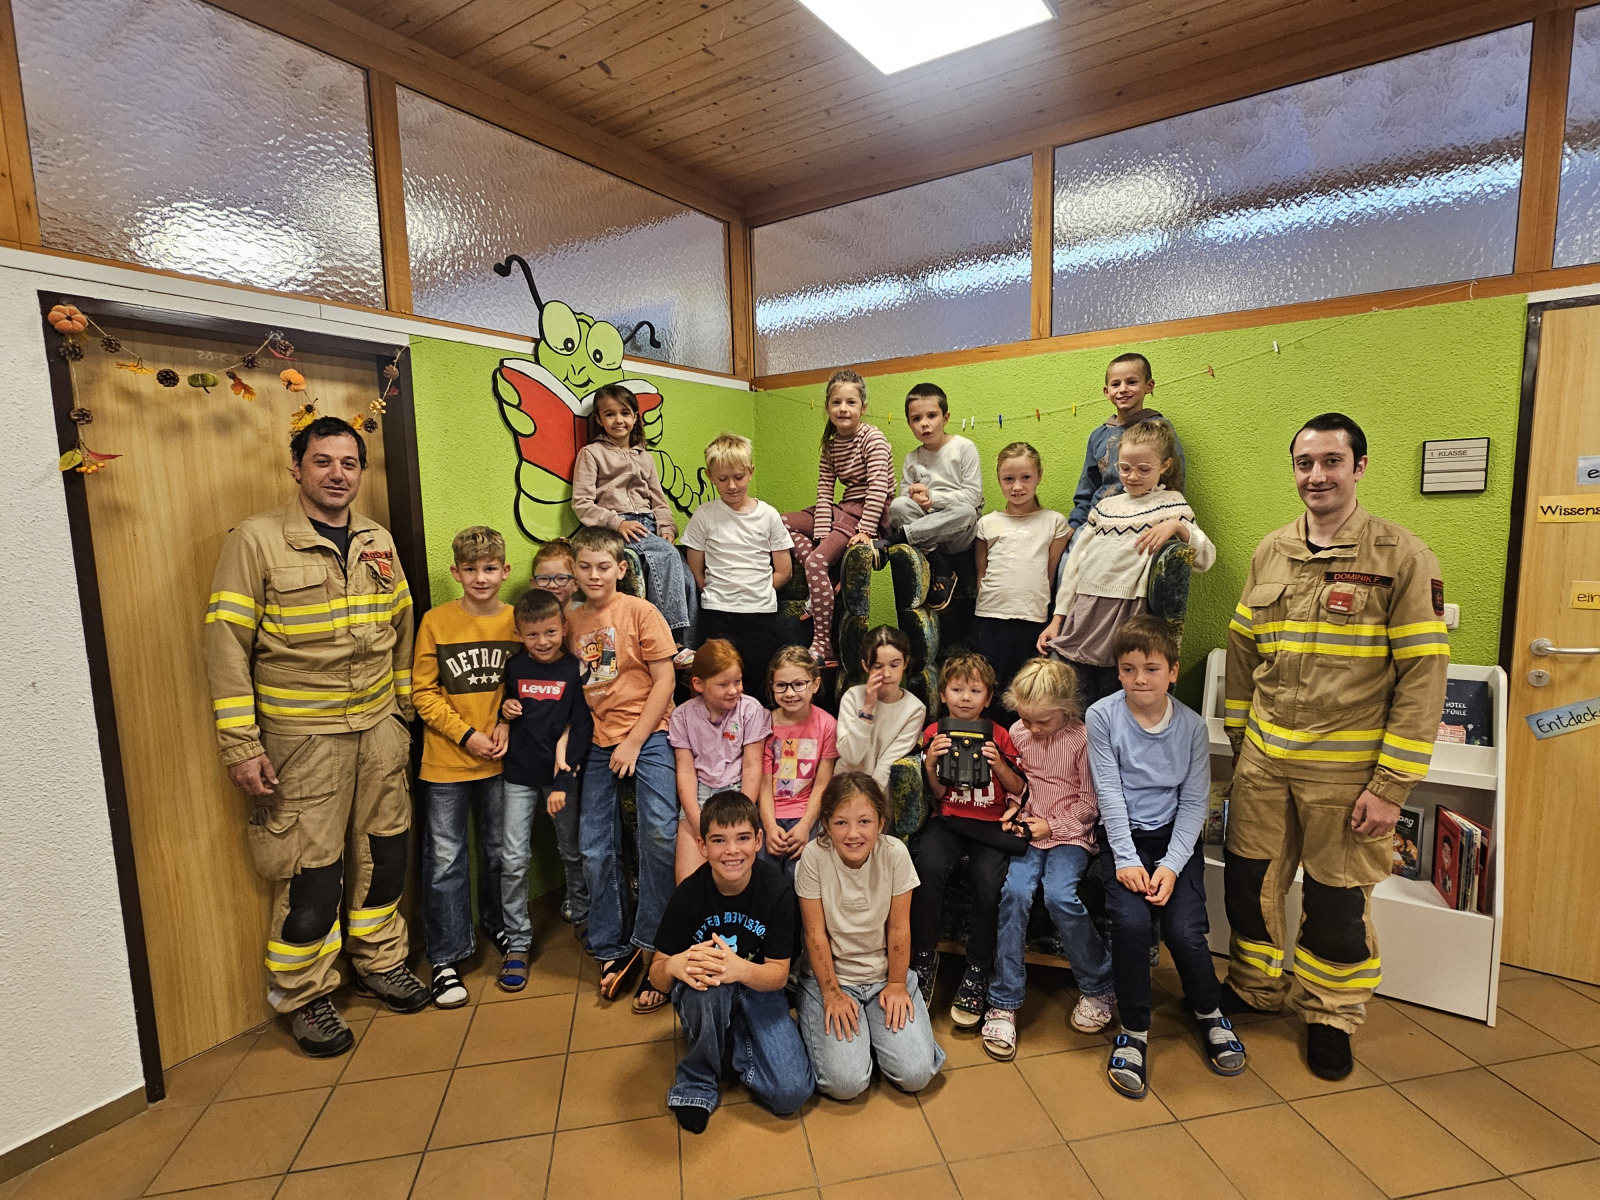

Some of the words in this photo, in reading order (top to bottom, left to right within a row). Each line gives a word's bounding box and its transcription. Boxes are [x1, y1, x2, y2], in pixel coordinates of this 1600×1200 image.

[1540, 505, 1600, 516] Wissens
[1334, 573, 1372, 582] DOMINIK
[1442, 708, 1467, 717] EFÜHLE
[1536, 706, 1600, 734] Entdeck
[1398, 815, 1414, 828] ong
[724, 912, 766, 940] DIVISIO
